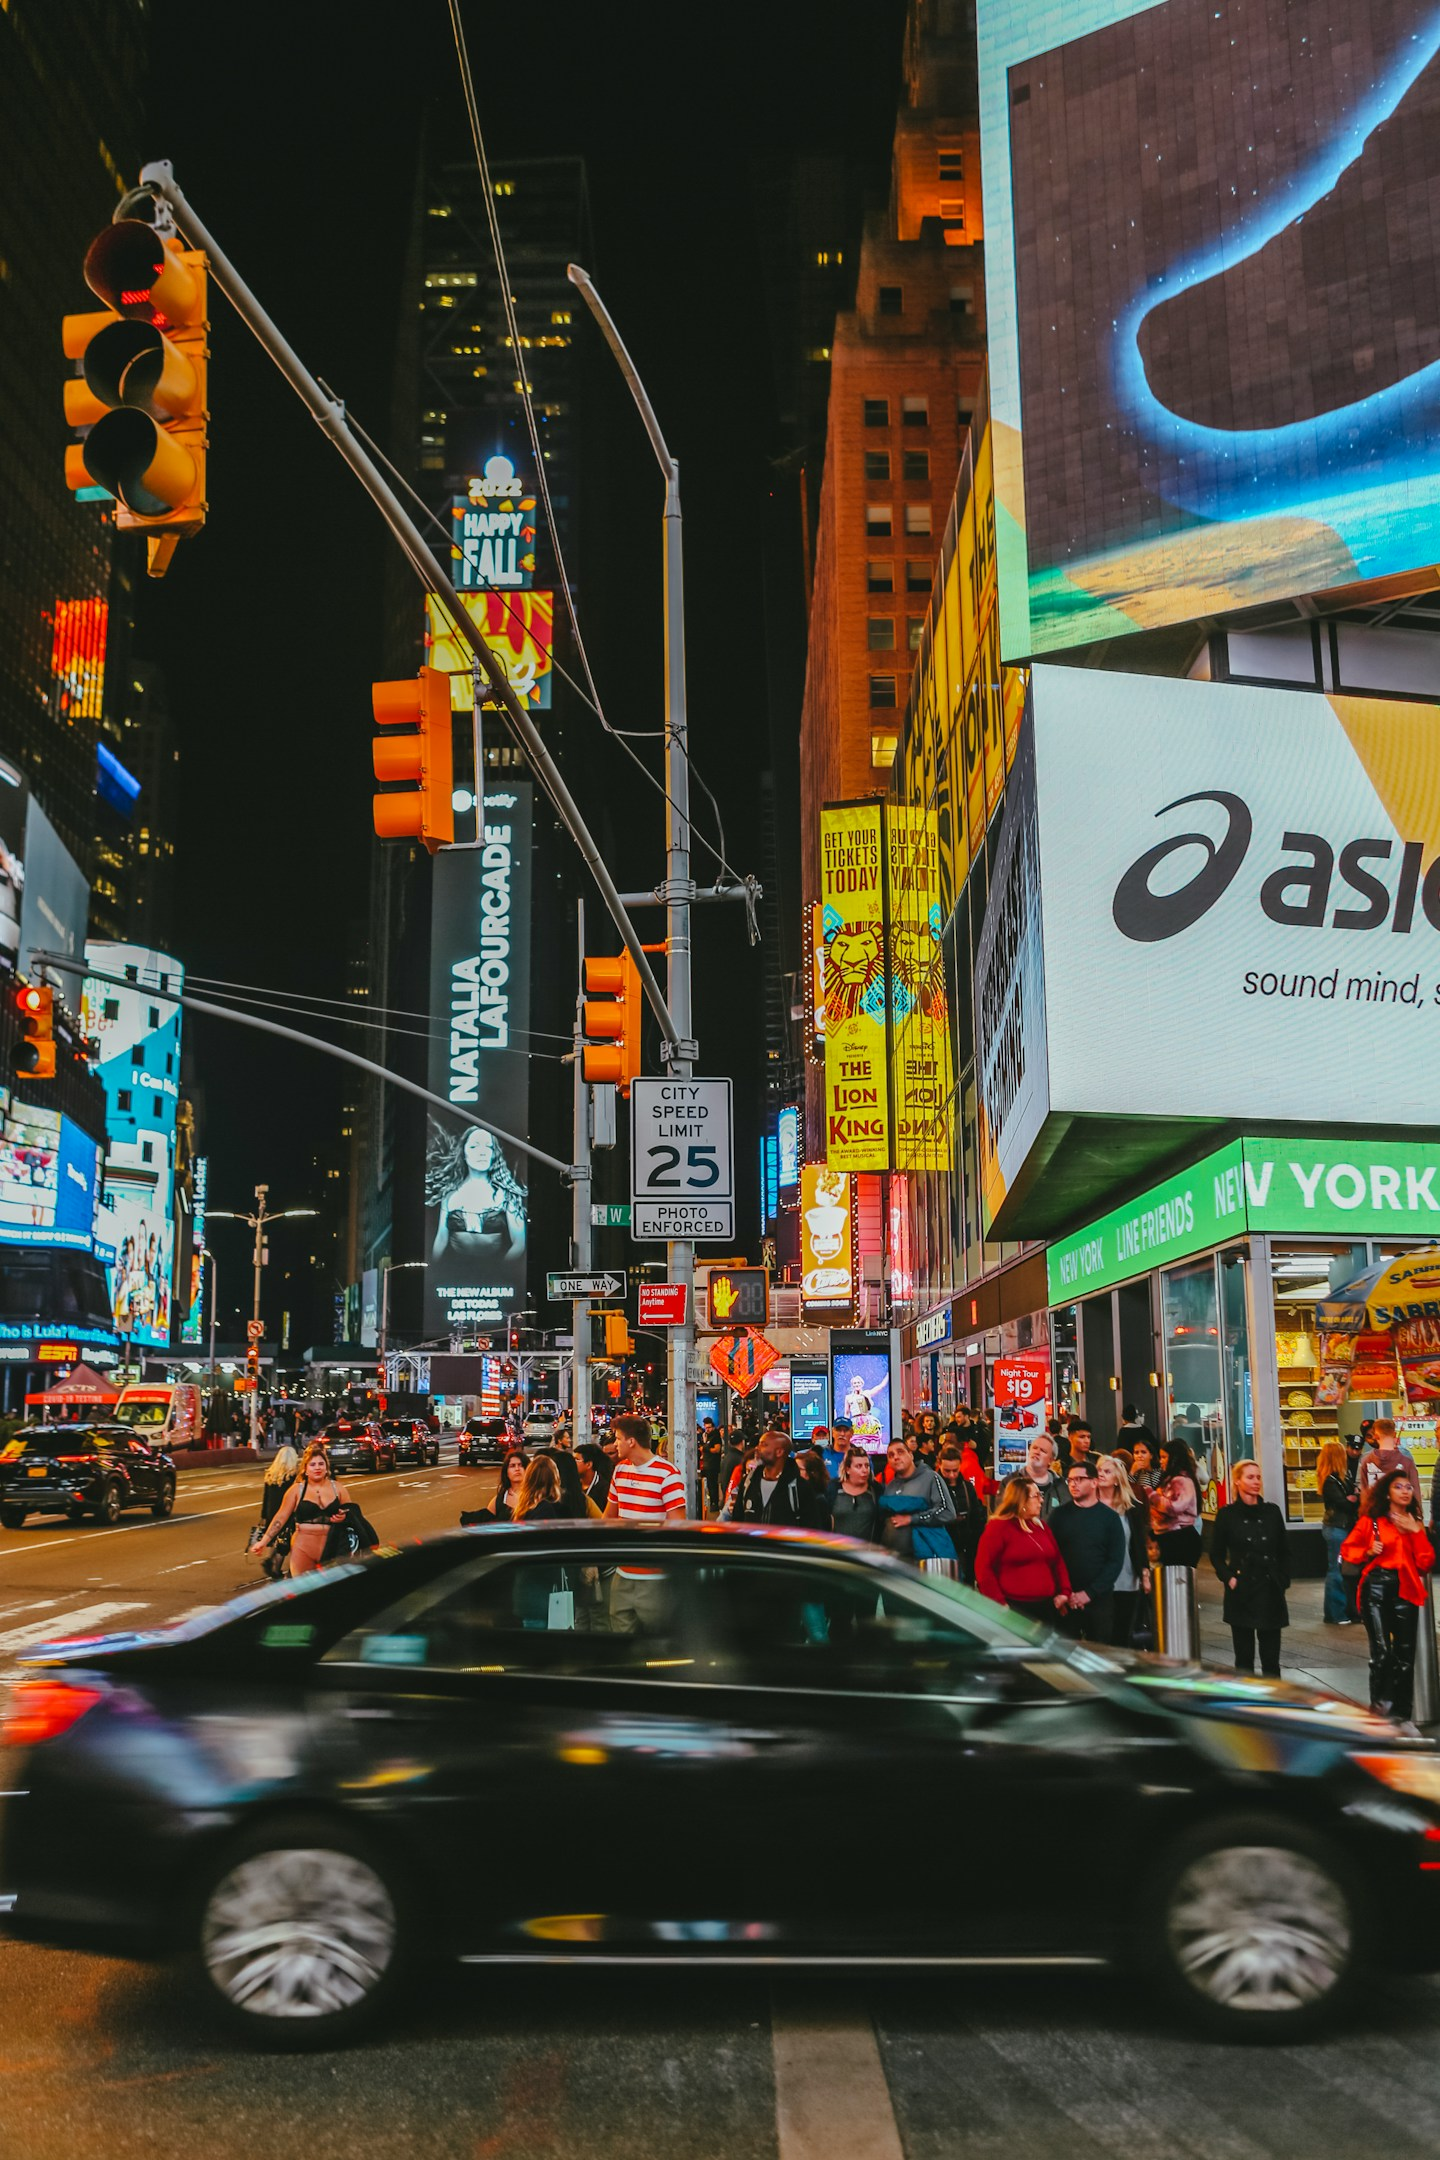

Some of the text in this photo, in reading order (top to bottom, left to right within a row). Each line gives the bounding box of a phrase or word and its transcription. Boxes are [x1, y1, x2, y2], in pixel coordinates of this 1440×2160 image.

[468, 478, 523, 497] 2022
[464, 513, 524, 537] HAPPY
[463, 538, 523, 585] FALL
[825, 828, 877, 849] GET YOUR
[825, 845, 877, 868] TICKETS
[825, 866, 878, 894] TODAY
[480, 825, 512, 1047] LAFOURCADE
[1243, 968, 1339, 999] sound
[1346, 970, 1425, 1008] mind,
[450, 956, 480, 1102] NATALIA
[842, 1042, 868, 1052] Disney
[839, 1061, 871, 1076] THE
[661, 1087, 700, 1100] CITY
[834, 1085, 877, 1111] LION
[652, 1105, 709, 1119] SPEED
[659, 1124, 704, 1137] LIMIT
[829, 1115, 884, 1145] KING
[647, 1145, 720, 1188] 25
[1214, 1161, 1440, 1219] NEW YORK
[610, 1208, 622, 1222] W
[658, 1207, 708, 1219] PHOTO
[642, 1221, 724, 1233] ENFORCED
[1116, 1191, 1194, 1262] LINE FRIENDS
[1060, 1237, 1104, 1286] NEW YORK
[436, 1287, 514, 1297] THE NEW ALBUM
[560, 1280, 614, 1291] ONE WAY
[651, 1287, 679, 1297] STANDING
[642, 1299, 664, 1307] Anytime
[38, 1344, 77, 1361] ESPN
[1001, 1369, 1039, 1379] Night Tour
[1007, 1379, 1033, 1398] $19
